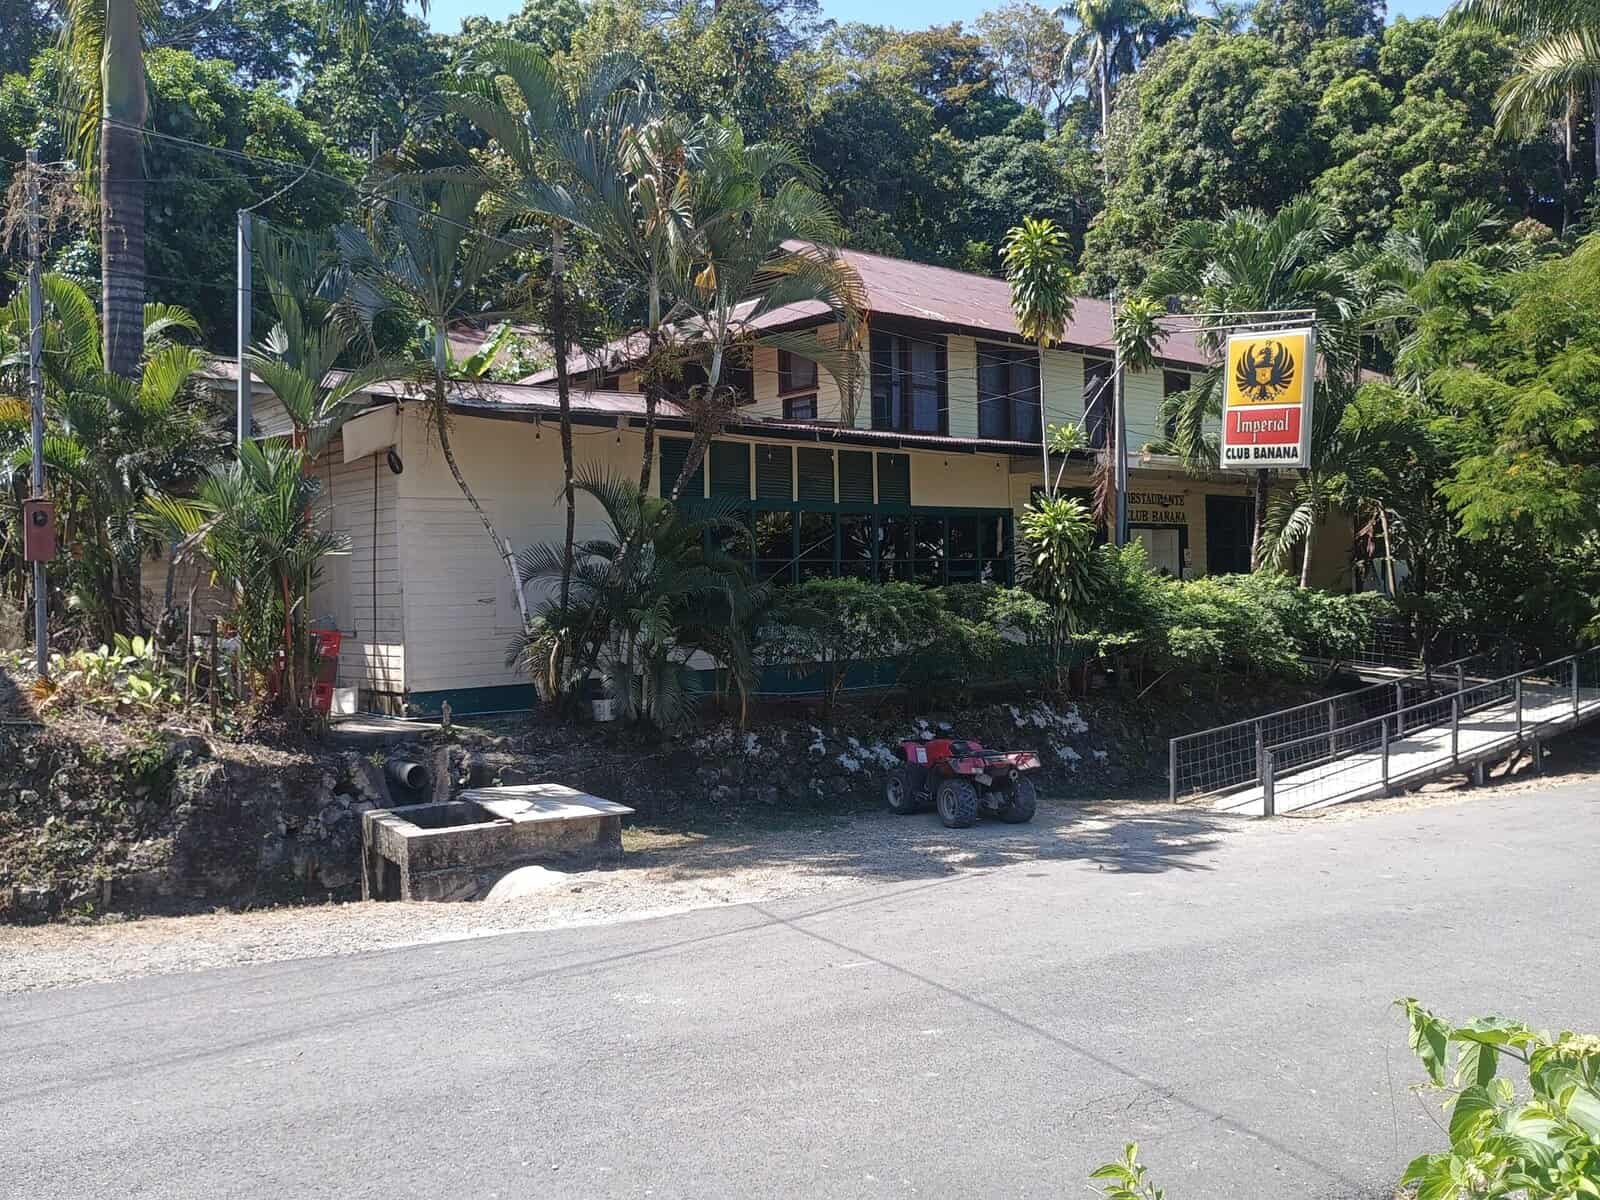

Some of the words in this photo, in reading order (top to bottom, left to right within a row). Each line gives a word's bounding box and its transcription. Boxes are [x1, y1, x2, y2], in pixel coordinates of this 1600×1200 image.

[1237, 409, 1289, 443] Imperial
[1225, 447, 1250, 460] CLUB
[1254, 446, 1299, 459] BANANA
